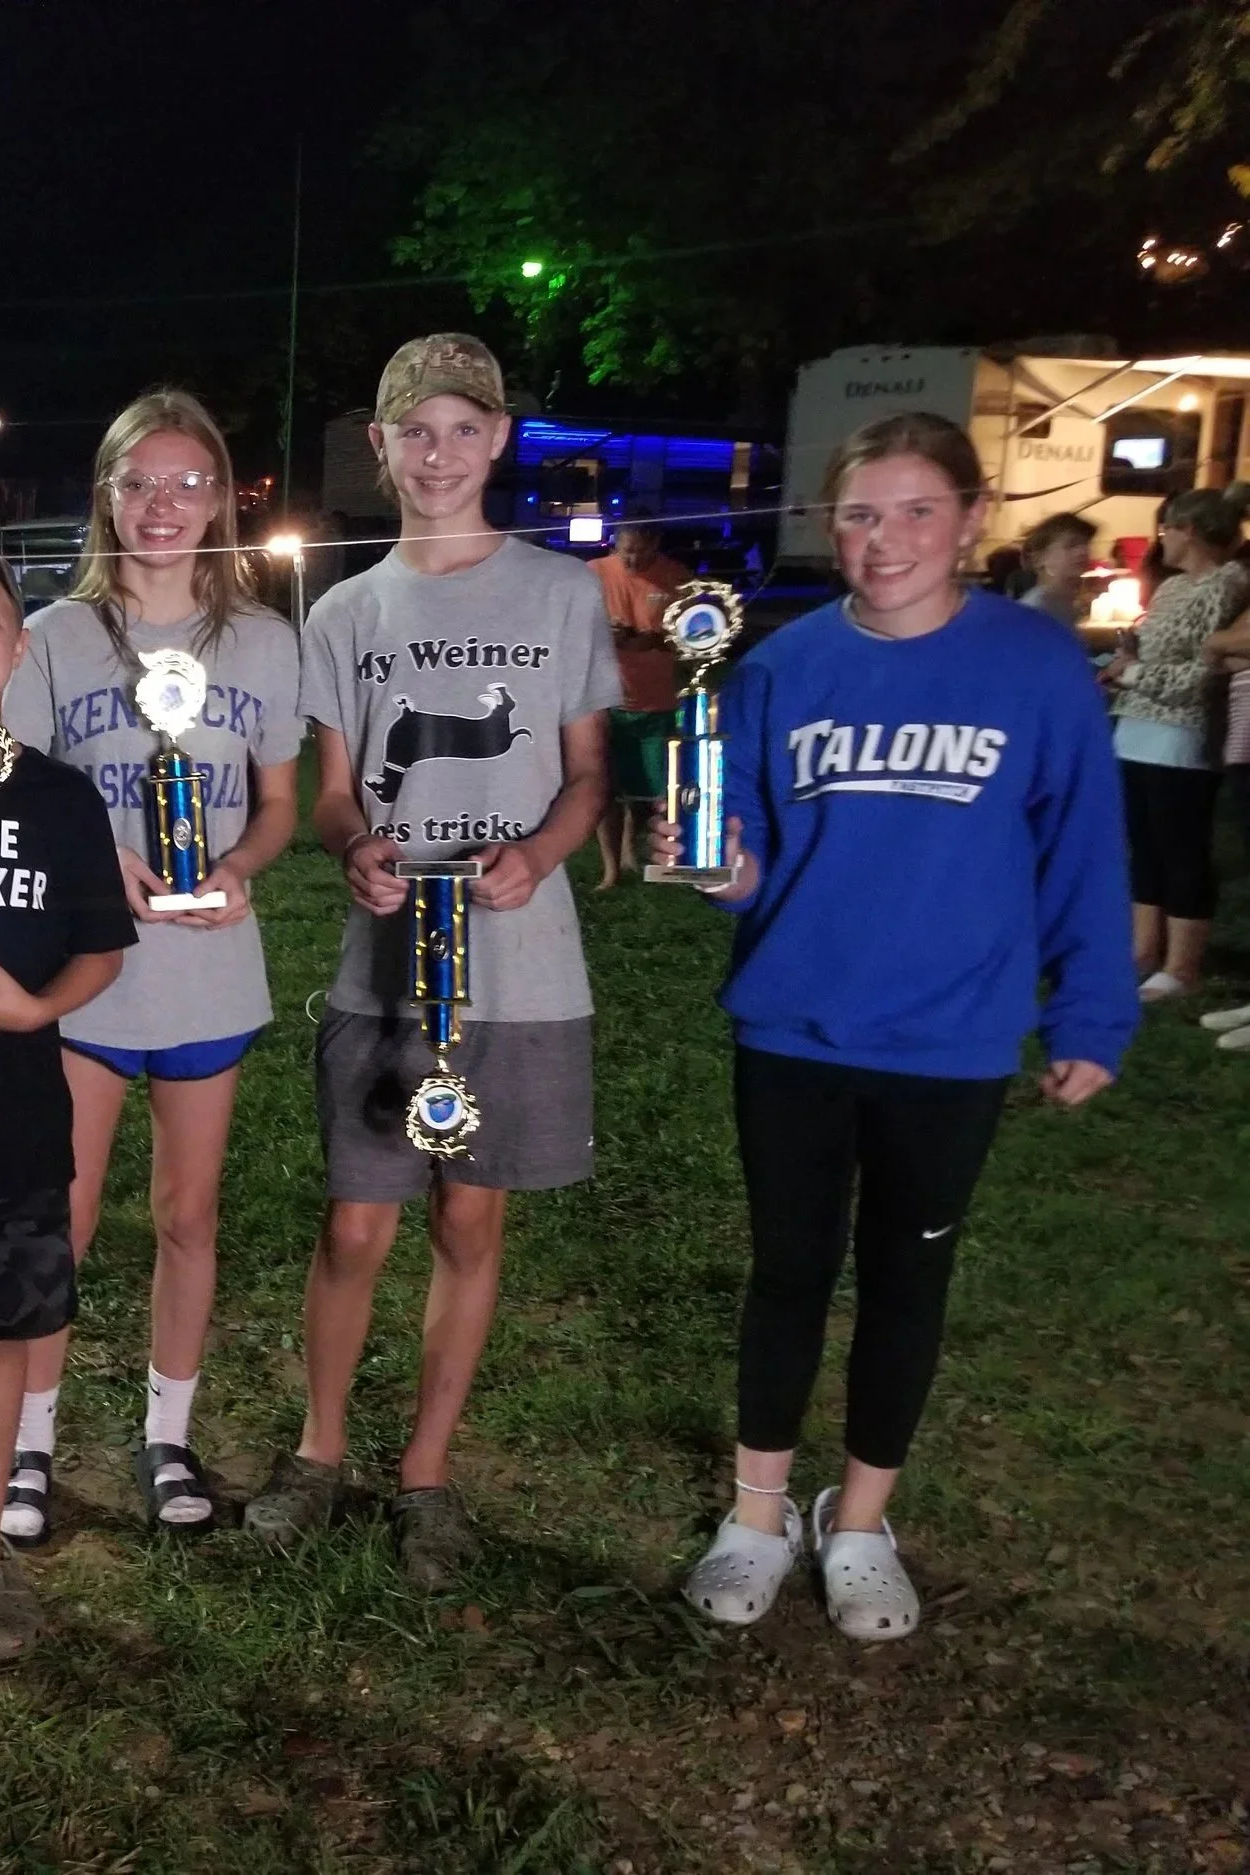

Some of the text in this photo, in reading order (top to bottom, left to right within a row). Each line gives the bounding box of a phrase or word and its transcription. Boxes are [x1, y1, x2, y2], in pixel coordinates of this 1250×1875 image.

[846, 377, 926, 398] DENALI
[1018, 441, 1094, 461] DENALI
[407, 637, 549, 671] Weiner
[58, 684, 263, 750] KENCKY
[788, 719, 1007, 788] TALONS
[422, 813, 524, 842] tricks
